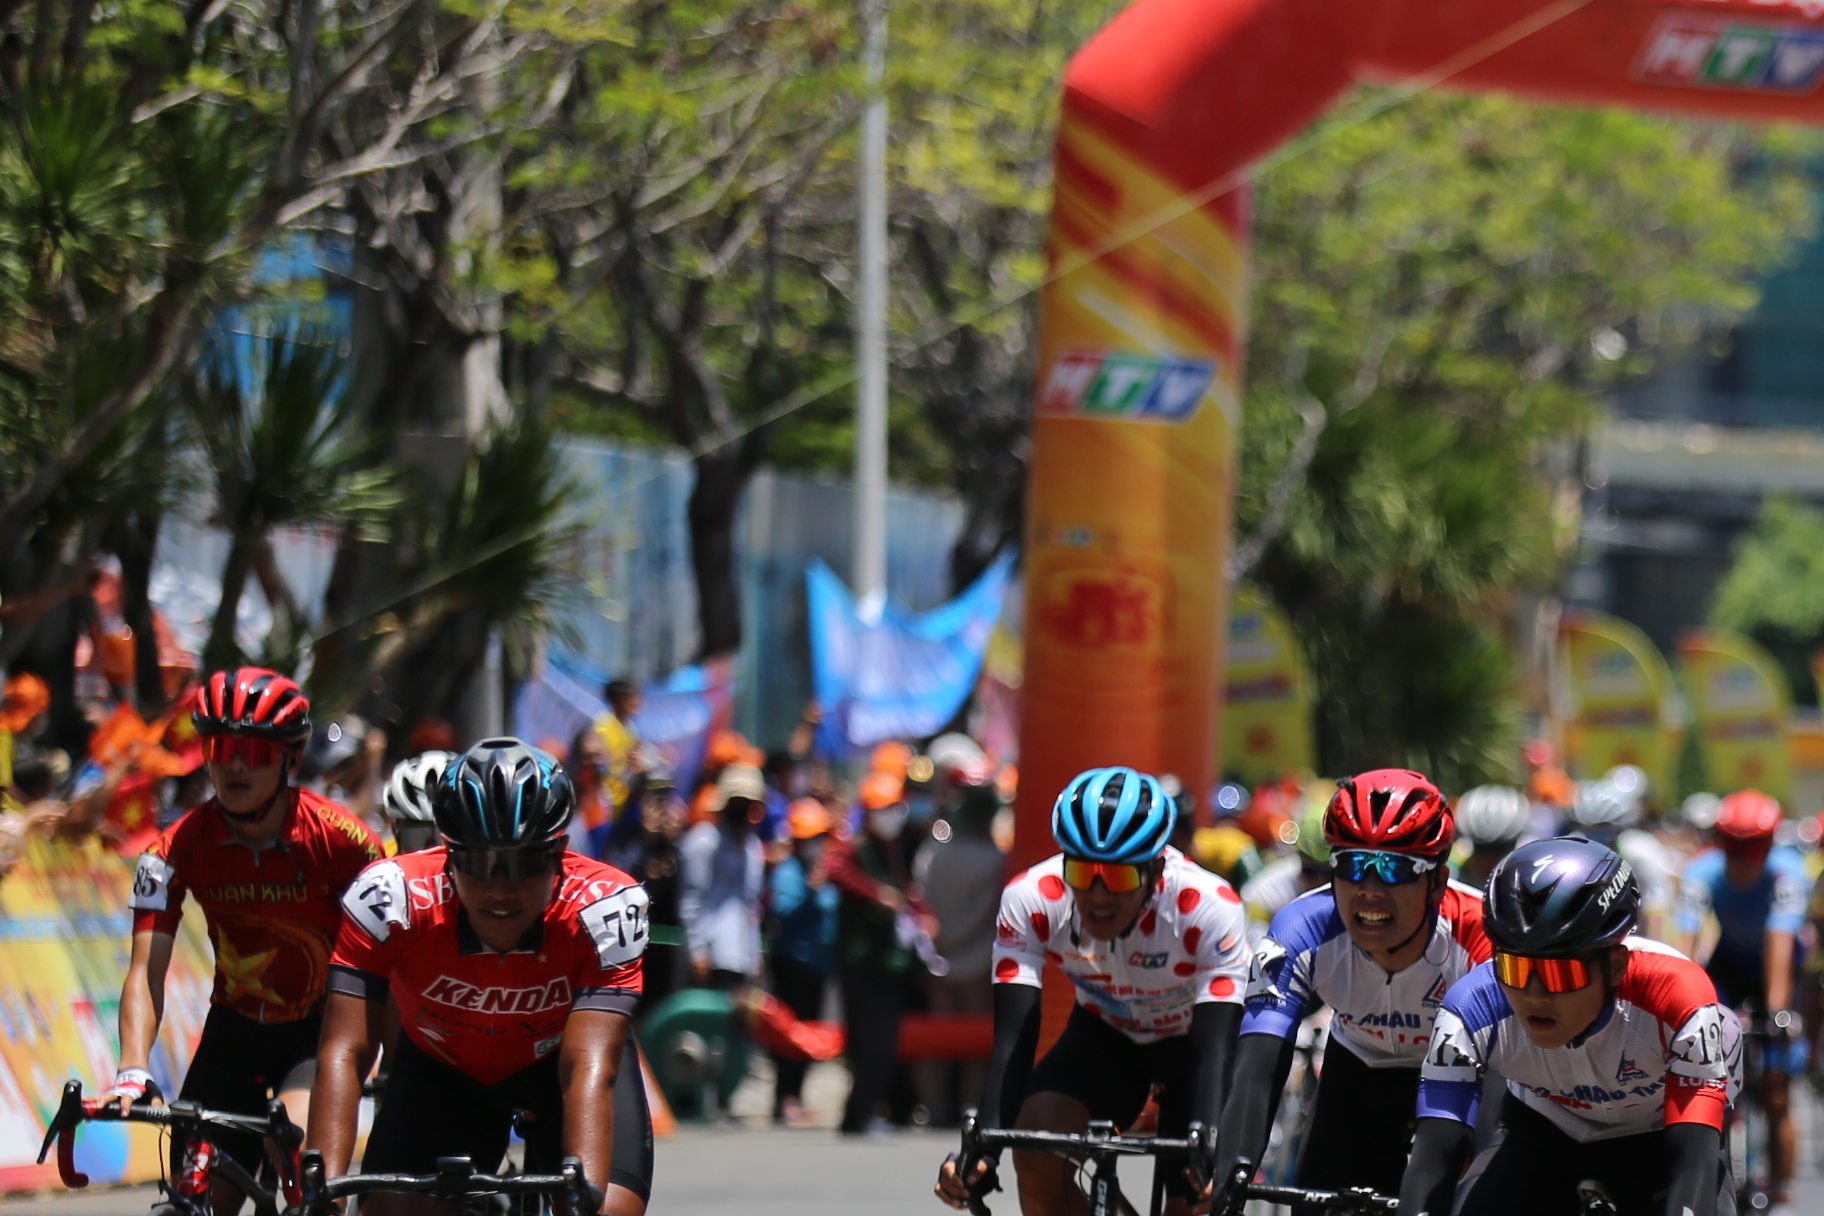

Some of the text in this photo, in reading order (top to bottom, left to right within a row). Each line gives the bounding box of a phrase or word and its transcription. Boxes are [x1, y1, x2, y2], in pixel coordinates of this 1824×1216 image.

[1046, 356, 1208, 412] HTV
[133, 867, 158, 898] 85
[602, 903, 645, 948] 72
[1130, 952, 1168, 967] HTV
[421, 974, 573, 1014] KENDA
